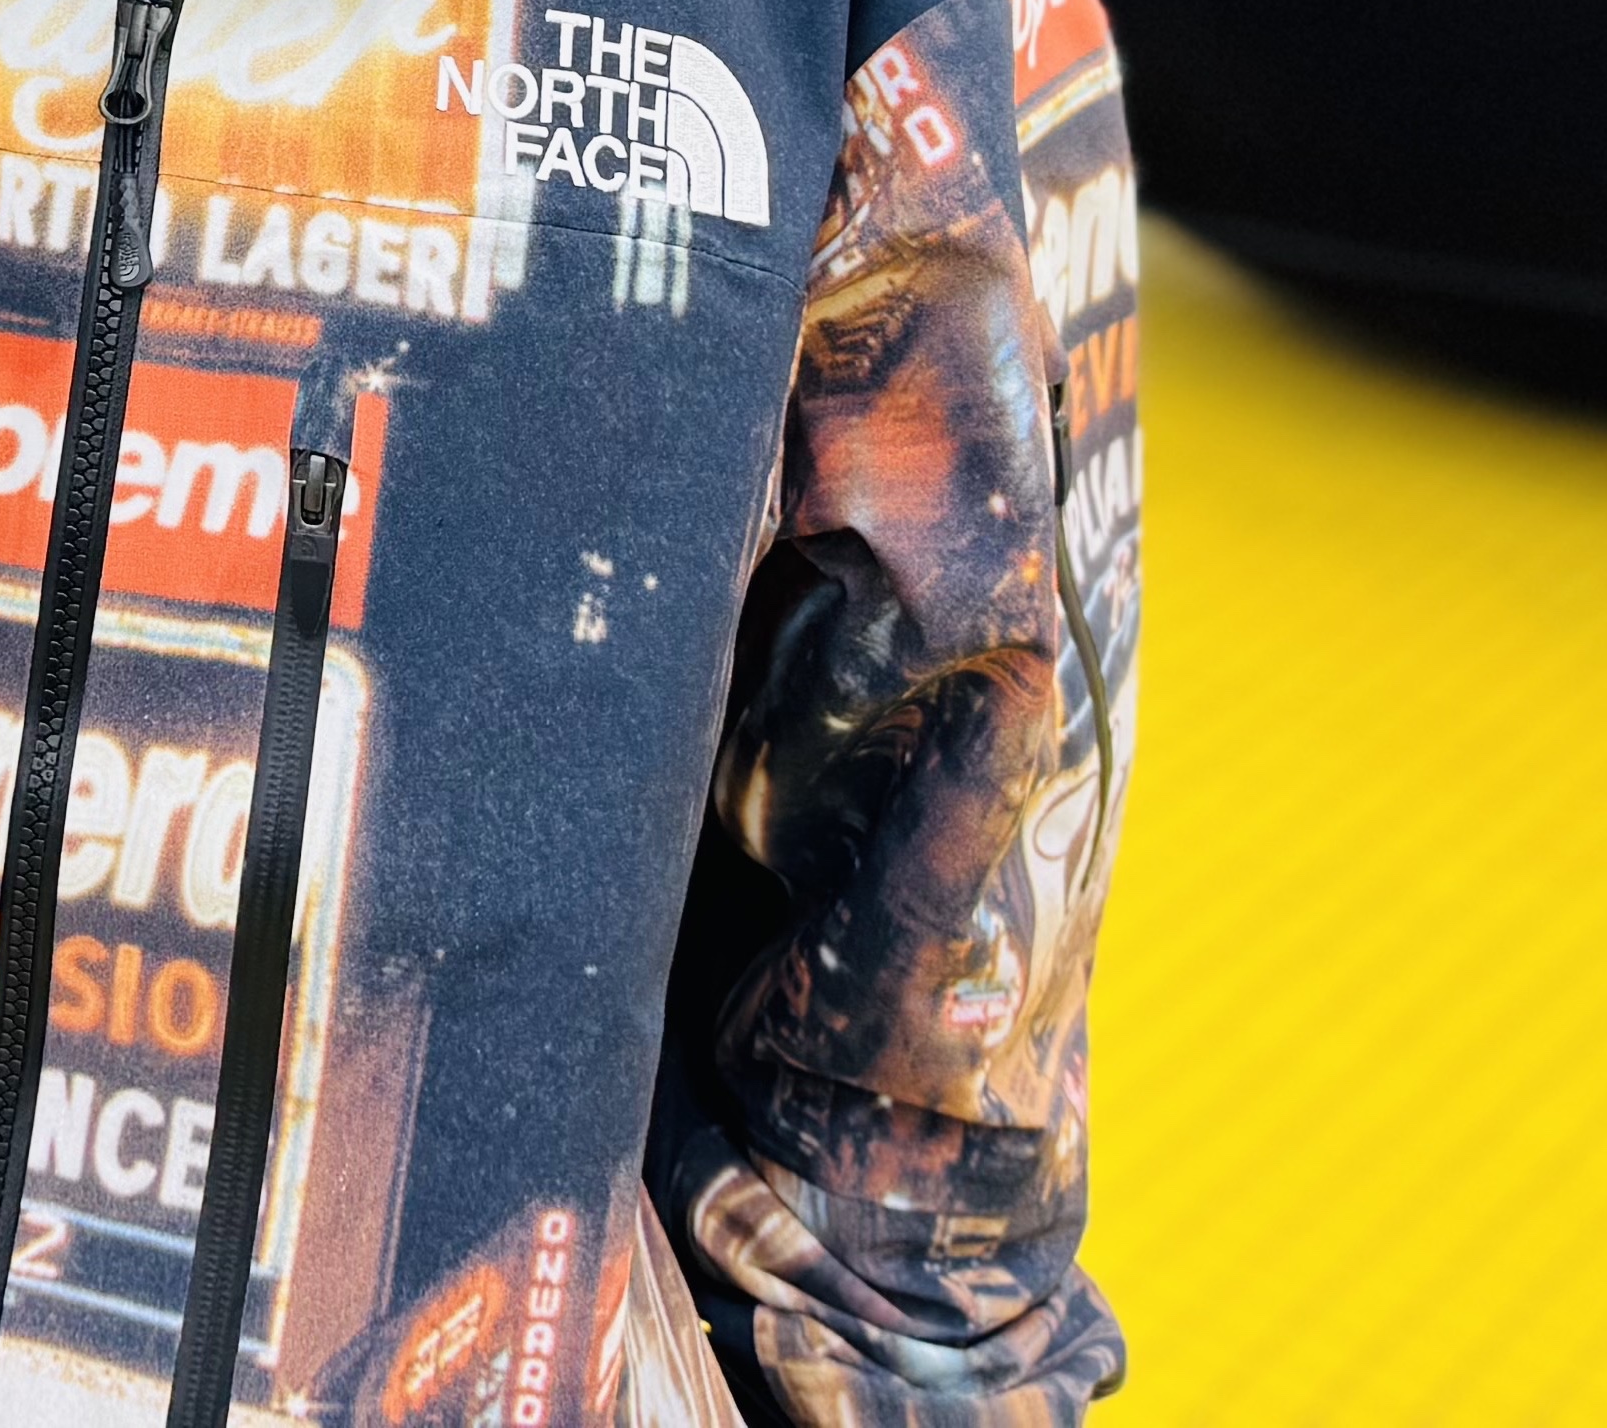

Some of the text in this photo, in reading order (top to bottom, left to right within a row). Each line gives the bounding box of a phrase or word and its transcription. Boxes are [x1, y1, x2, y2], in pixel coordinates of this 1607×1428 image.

[545, 8, 673, 86] THE
[436, 55, 668, 148] NORTH
[504, 120, 668, 202] FACE
[199, 192, 456, 318] LAGER
